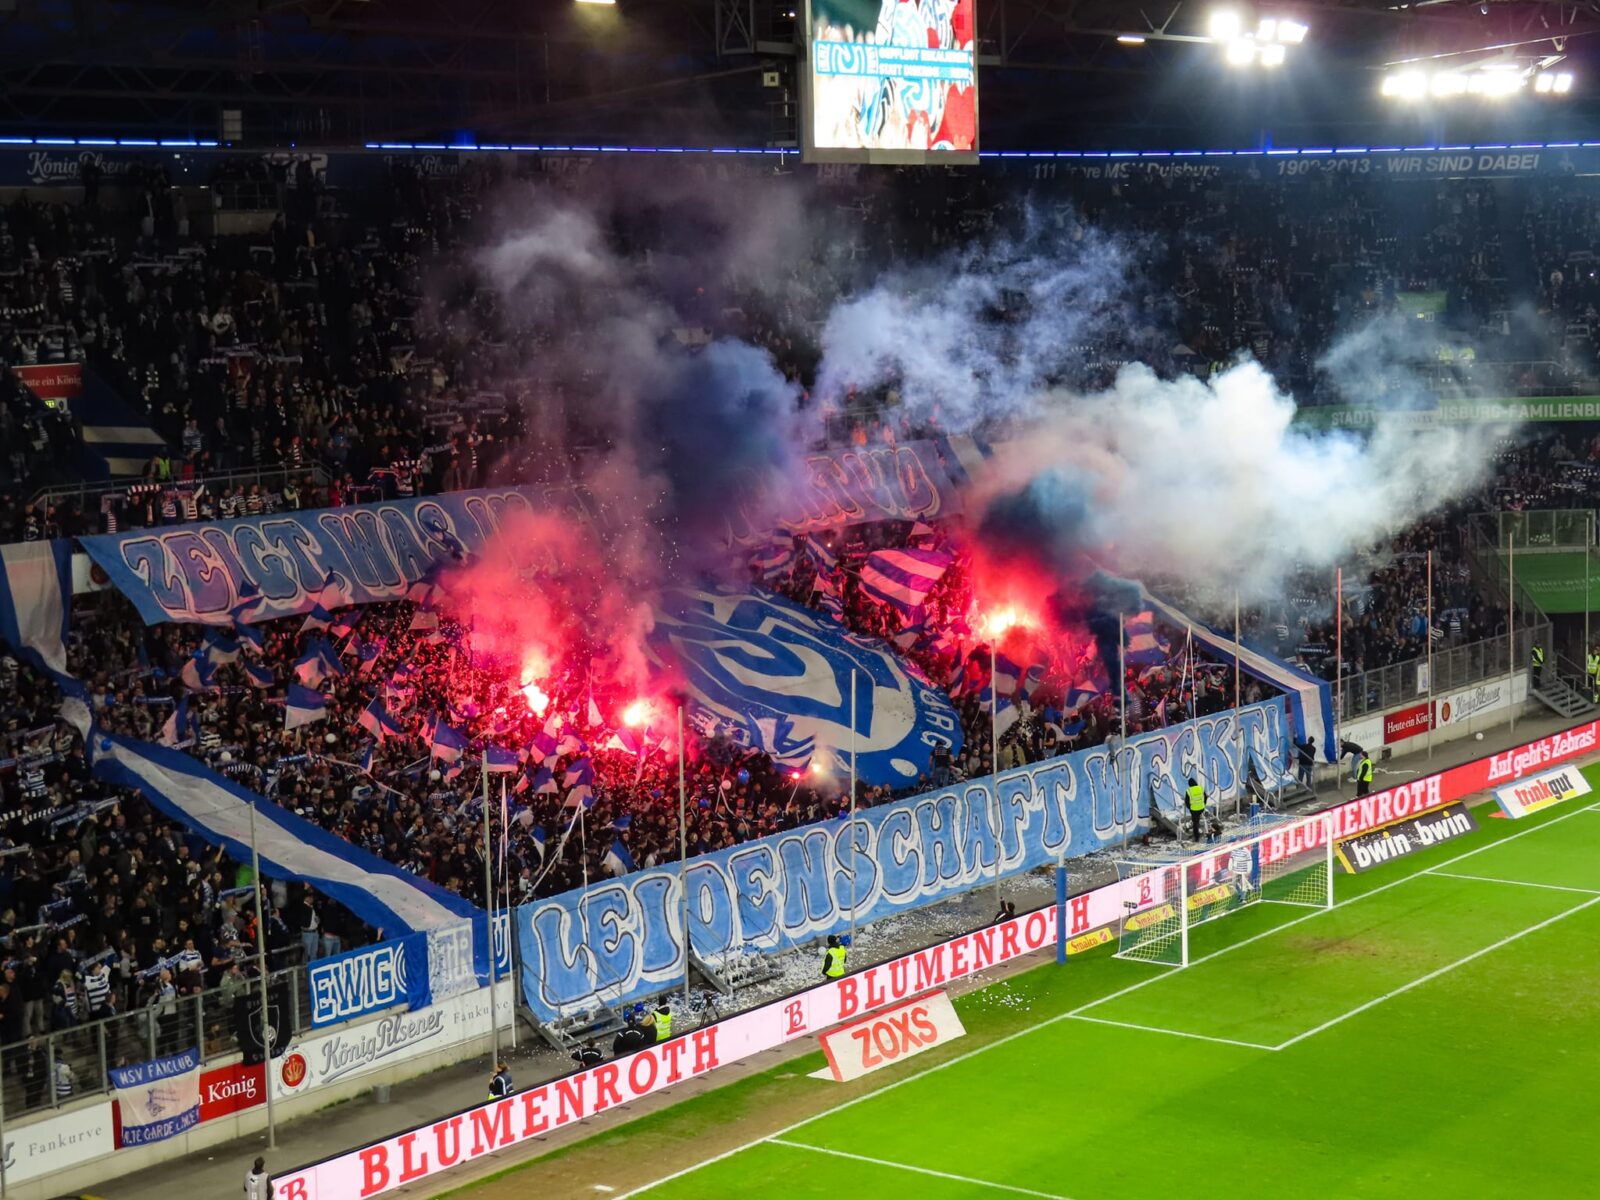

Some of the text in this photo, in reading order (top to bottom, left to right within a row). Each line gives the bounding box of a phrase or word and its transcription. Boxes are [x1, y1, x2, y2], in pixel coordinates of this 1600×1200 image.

[1034, 163, 1057, 179] 111
[1387, 157, 1421, 173] WIR
[1425, 155, 1475, 172] SIND
[1478, 154, 1540, 171] DABEI
[120, 520, 348, 624] ZEIGT
[1387, 720, 1406, 734] Heute
[1405, 716, 1415, 728] ein
[1488, 722, 1596, 780] Auf geht's Zebras!
[1514, 772, 1574, 807] trinkgut
[1269, 774, 1442, 864] BLUMENROTH
[1351, 810, 1471, 868] bwin bwin
[531, 705, 1287, 1013] LEIDENSCHAFT WECKT!
[311, 947, 396, 1024] EWIG
[319, 1035, 377, 1076] König
[375, 1009, 444, 1052] Pilsener
[852, 1006, 938, 1069] ZOXS
[119, 1068, 143, 1084] MSV
[208, 1076, 257, 1104] König
[143, 1121, 175, 1141] GARDE
[359, 1025, 718, 1198] BLUMENROTH
[29, 1125, 103, 1157] Fankurve
